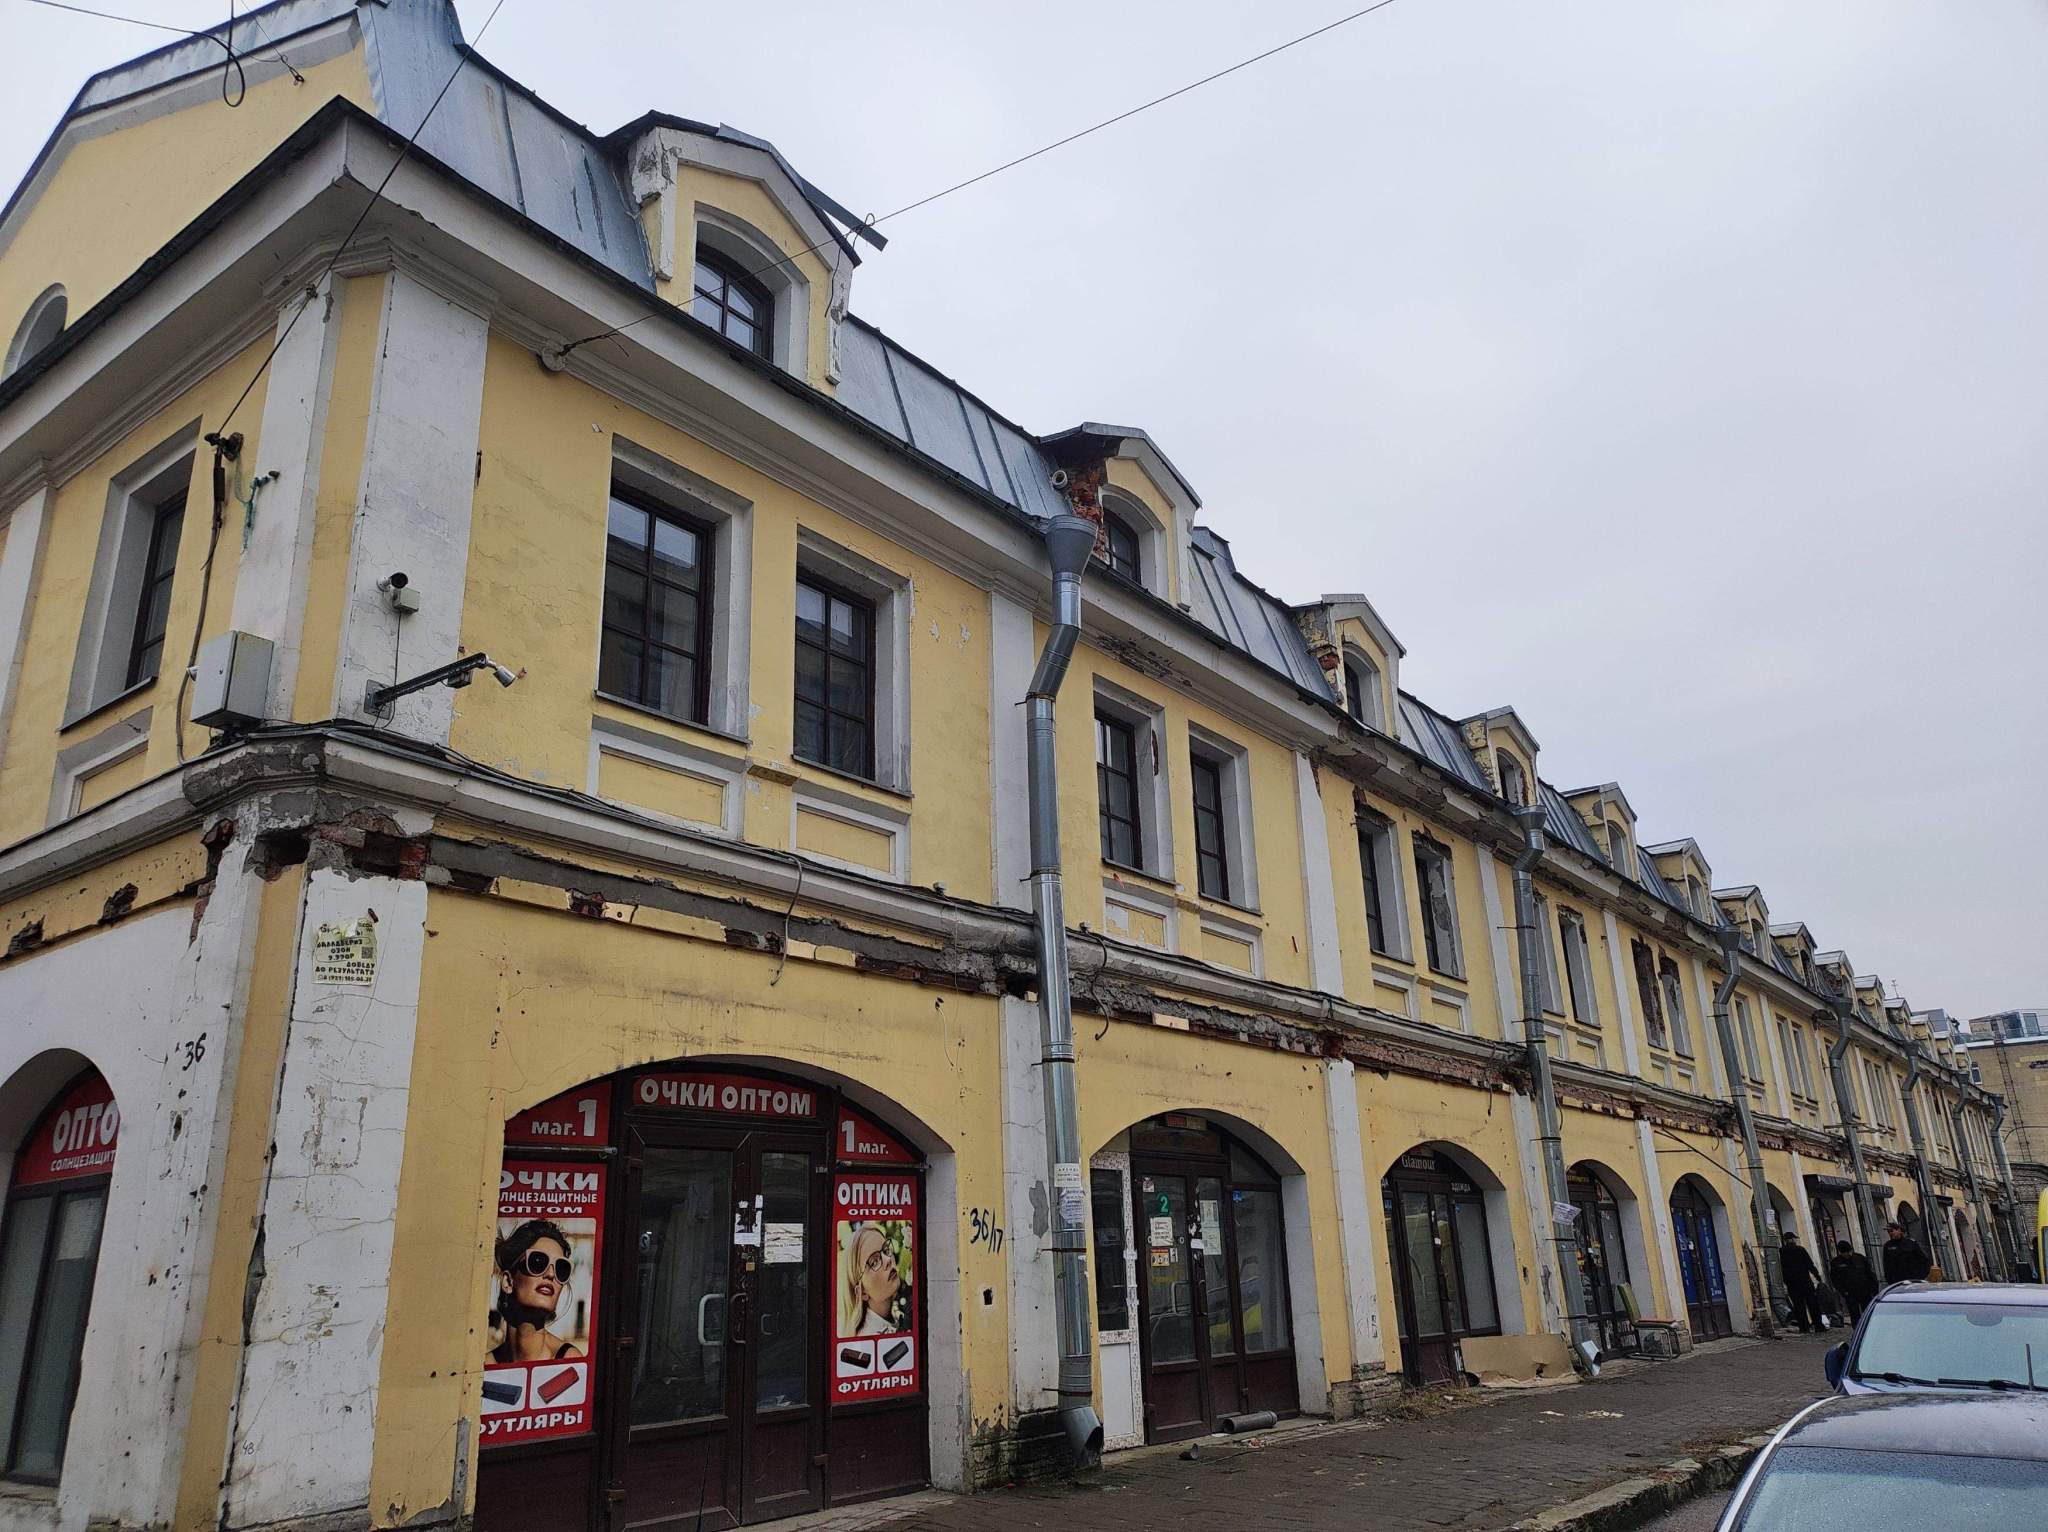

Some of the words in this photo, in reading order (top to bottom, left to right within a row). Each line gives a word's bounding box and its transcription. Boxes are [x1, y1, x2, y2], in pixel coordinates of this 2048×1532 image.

[182, 1032, 207, 1071] 36
[640, 1078, 715, 1108] ОЧКИ
[721, 1086, 811, 1116] ОПТОМ
[531, 1121, 577, 1136] маг.
[578, 1099, 598, 1137] 1
[841, 1120, 855, 1153] 1
[858, 1142, 889, 1155] маг.
[1401, 1155, 1436, 1170] Glamour
[837, 1182, 912, 1206] ОПТИКА
[1160, 1196, 1169, 1212] 2
[499, 1205, 583, 1214] ОПТОМ
[848, 1208, 903, 1216] ОПТОМ
[838, 1375, 913, 1393] ФУТЛЯРЫ
